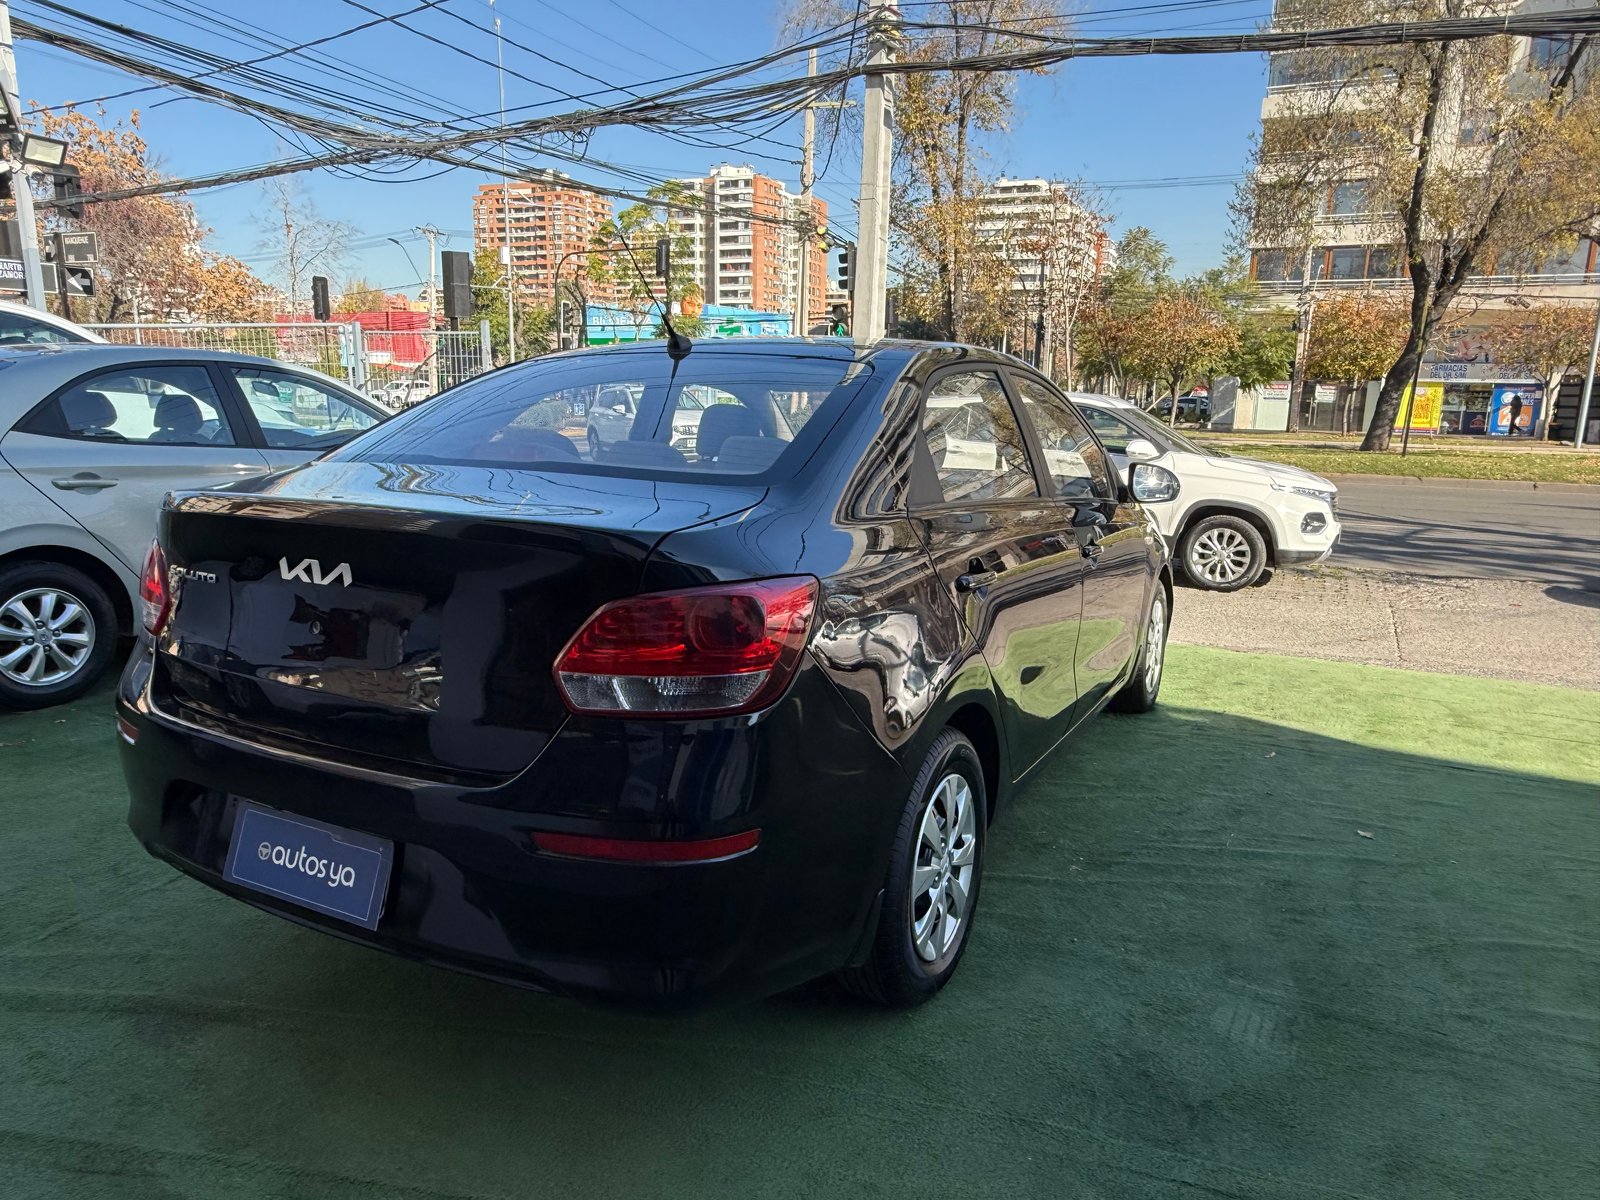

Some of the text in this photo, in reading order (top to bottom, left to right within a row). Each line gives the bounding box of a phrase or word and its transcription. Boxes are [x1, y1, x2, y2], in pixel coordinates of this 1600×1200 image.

[0, 270, 26, 280] ZAMOR
[1430, 364, 1468, 372] FARMACIAS
[1430, 371, 1442, 379] DEL
[169, 564, 217, 584] SOLUTO
[279, 556, 353, 588] KIA
[272, 845, 356, 888] autos ya
